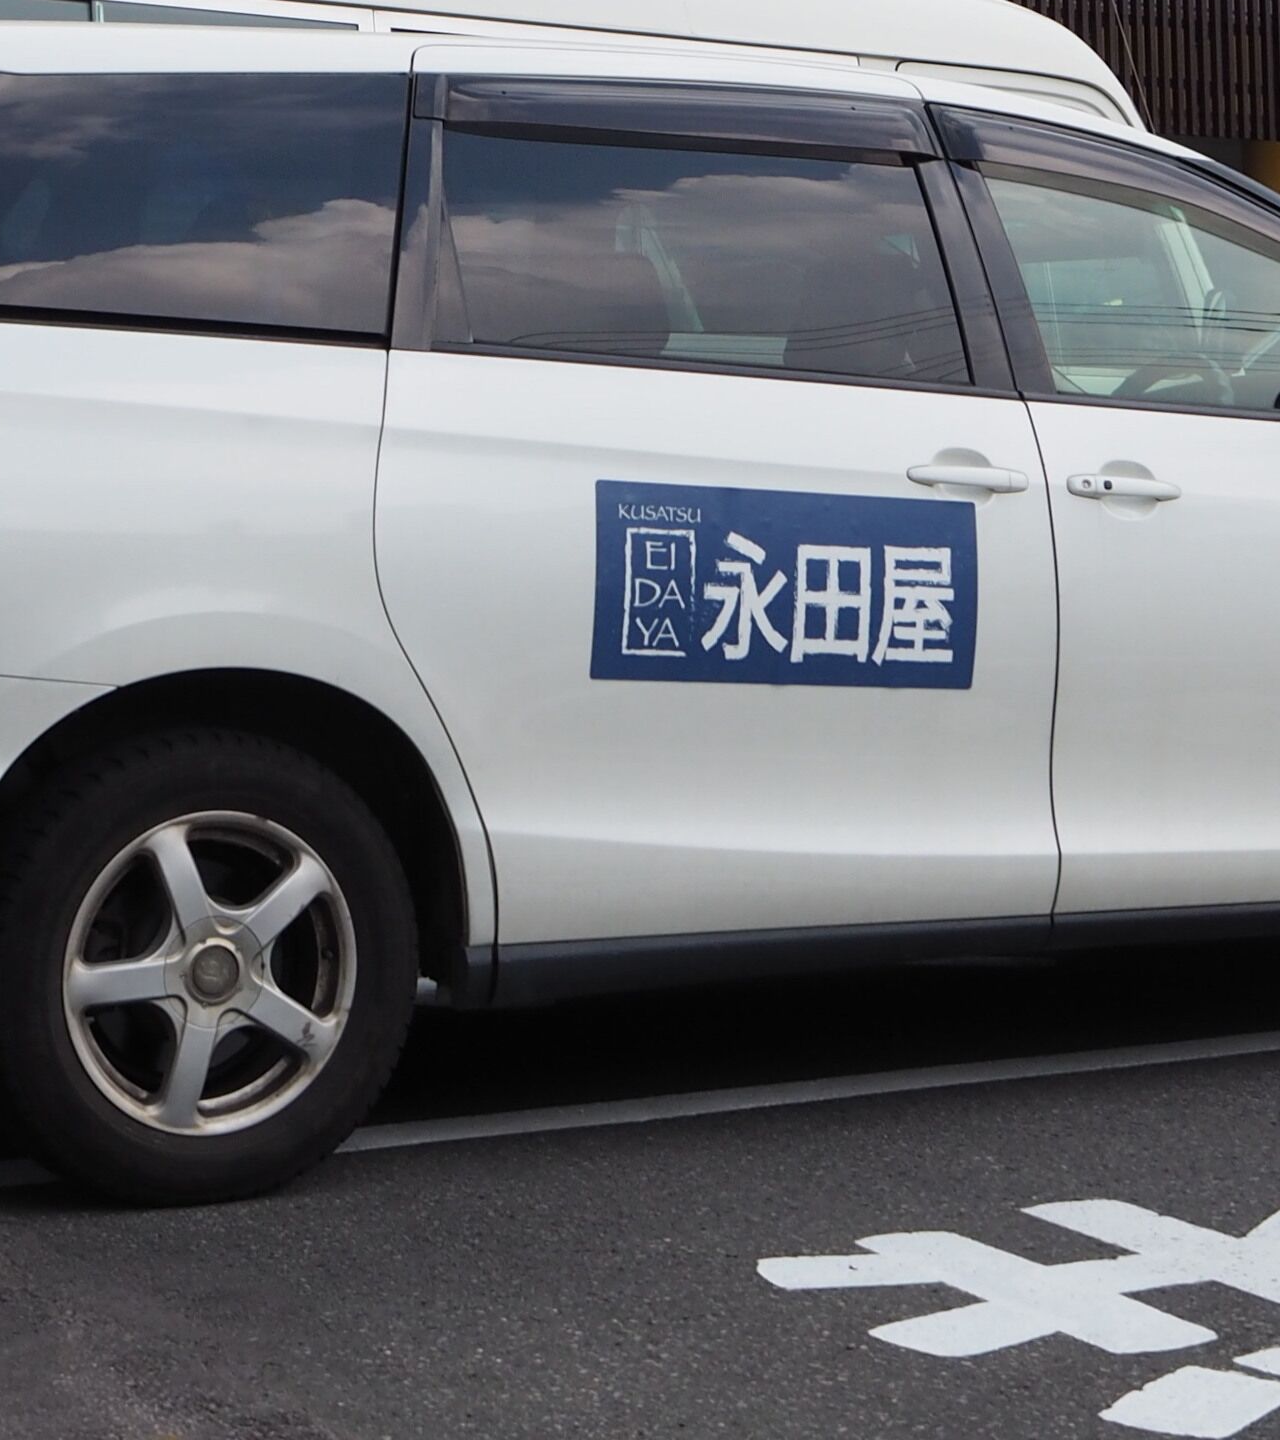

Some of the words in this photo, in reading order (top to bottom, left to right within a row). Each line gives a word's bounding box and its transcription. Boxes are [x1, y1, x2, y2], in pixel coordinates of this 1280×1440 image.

[618, 503, 702, 524] KUSATSU
[645, 540, 676, 571] EI
[633, 578, 685, 610] DA
[700, 531, 955, 667] 永田屋
[635, 617, 680, 648] YA
